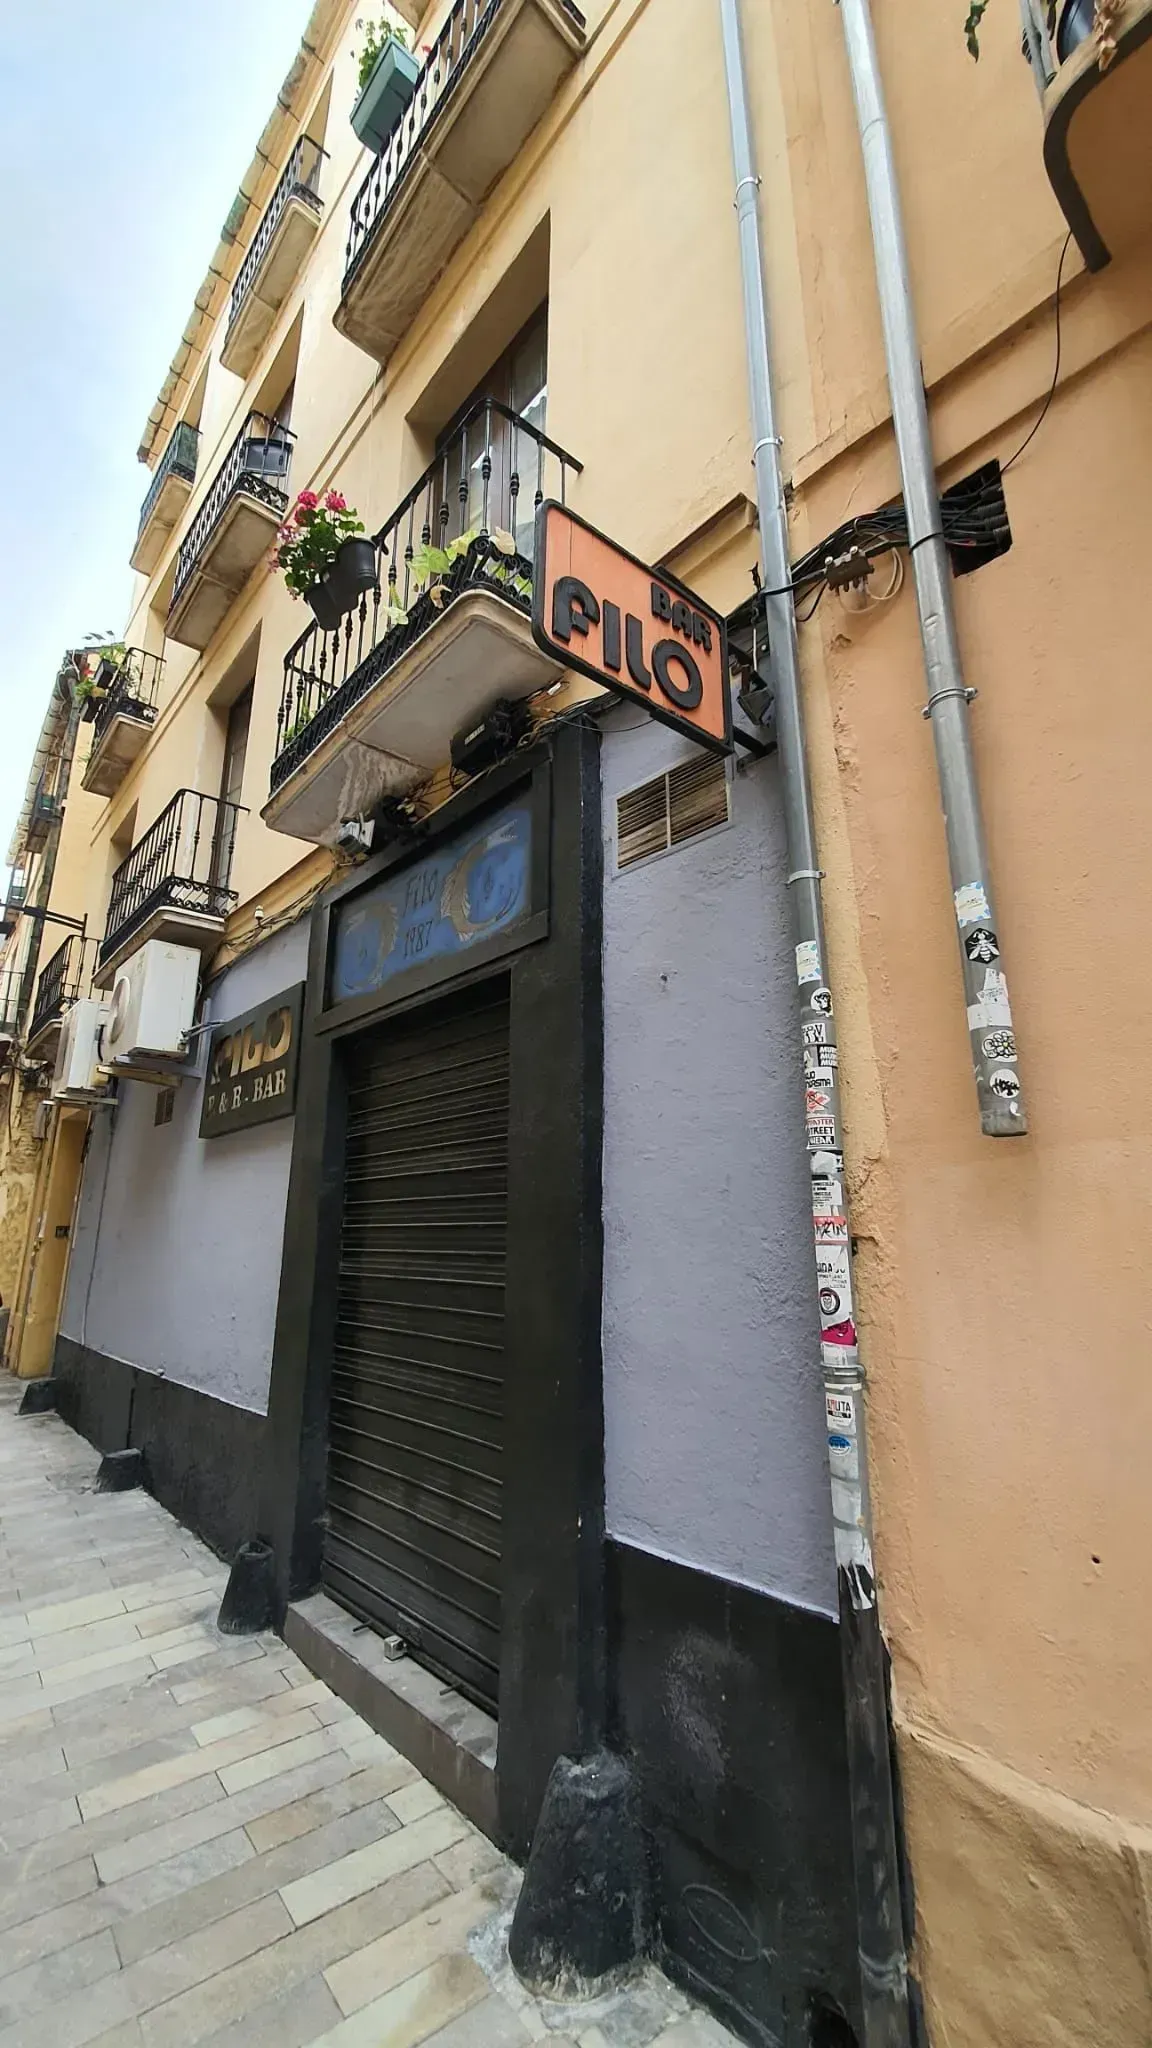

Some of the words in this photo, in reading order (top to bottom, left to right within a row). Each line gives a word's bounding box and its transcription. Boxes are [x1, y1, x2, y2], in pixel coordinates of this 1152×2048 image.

[650, 581, 712, 655] BAR
[231, 1085, 242, 1110] R
[252, 1068, 287, 1103] BAR
